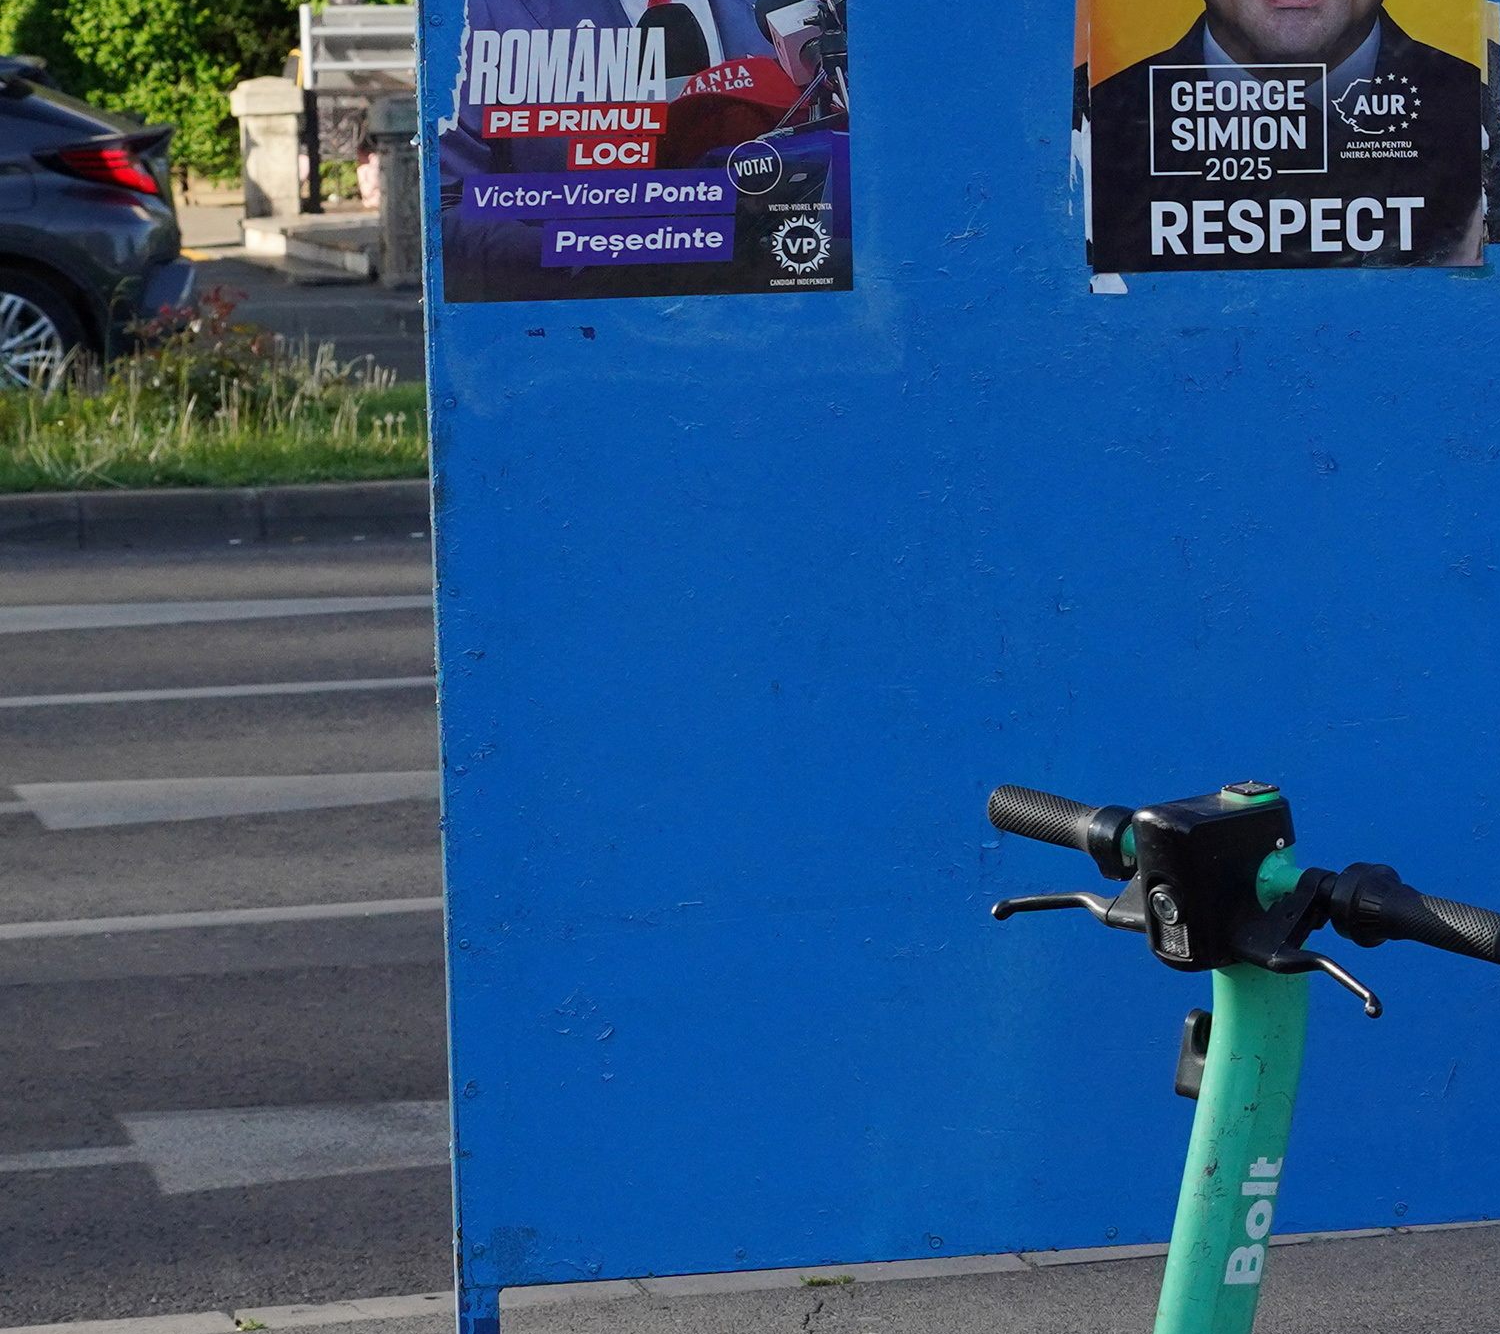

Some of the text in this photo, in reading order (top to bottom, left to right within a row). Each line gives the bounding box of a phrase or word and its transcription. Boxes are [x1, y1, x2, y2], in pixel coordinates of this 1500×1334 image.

[469, 19, 667, 105] ROMÂNIA
[725, 78, 754, 91] LOC
[1170, 79, 1306, 112] GEORGE
[1353, 94, 1406, 116] AUR
[489, 107, 661, 134] PE PRIMUL
[1171, 115, 1307, 152] SIMION
[1346, 141, 1412, 151] ALIANȚA PENTRU
[574, 140, 650, 167] LOC!
[1340, 148, 1419, 159] UNIREA ROMÂNILOR
[734, 156, 774, 178] VOTAT
[1205, 157, 1272, 181] 2025
[474, 181, 723, 208] Victor-Viorel Ponta
[768, 204, 811, 212] VICTOR-VIOREL
[1150, 196, 1425, 256] RESPECT
[555, 227, 724, 259] Președinte
[785, 237, 817, 254] VP
[797, 278, 834, 286] INDEPENDENT
[1224, 1156, 1285, 1286] Bolt
